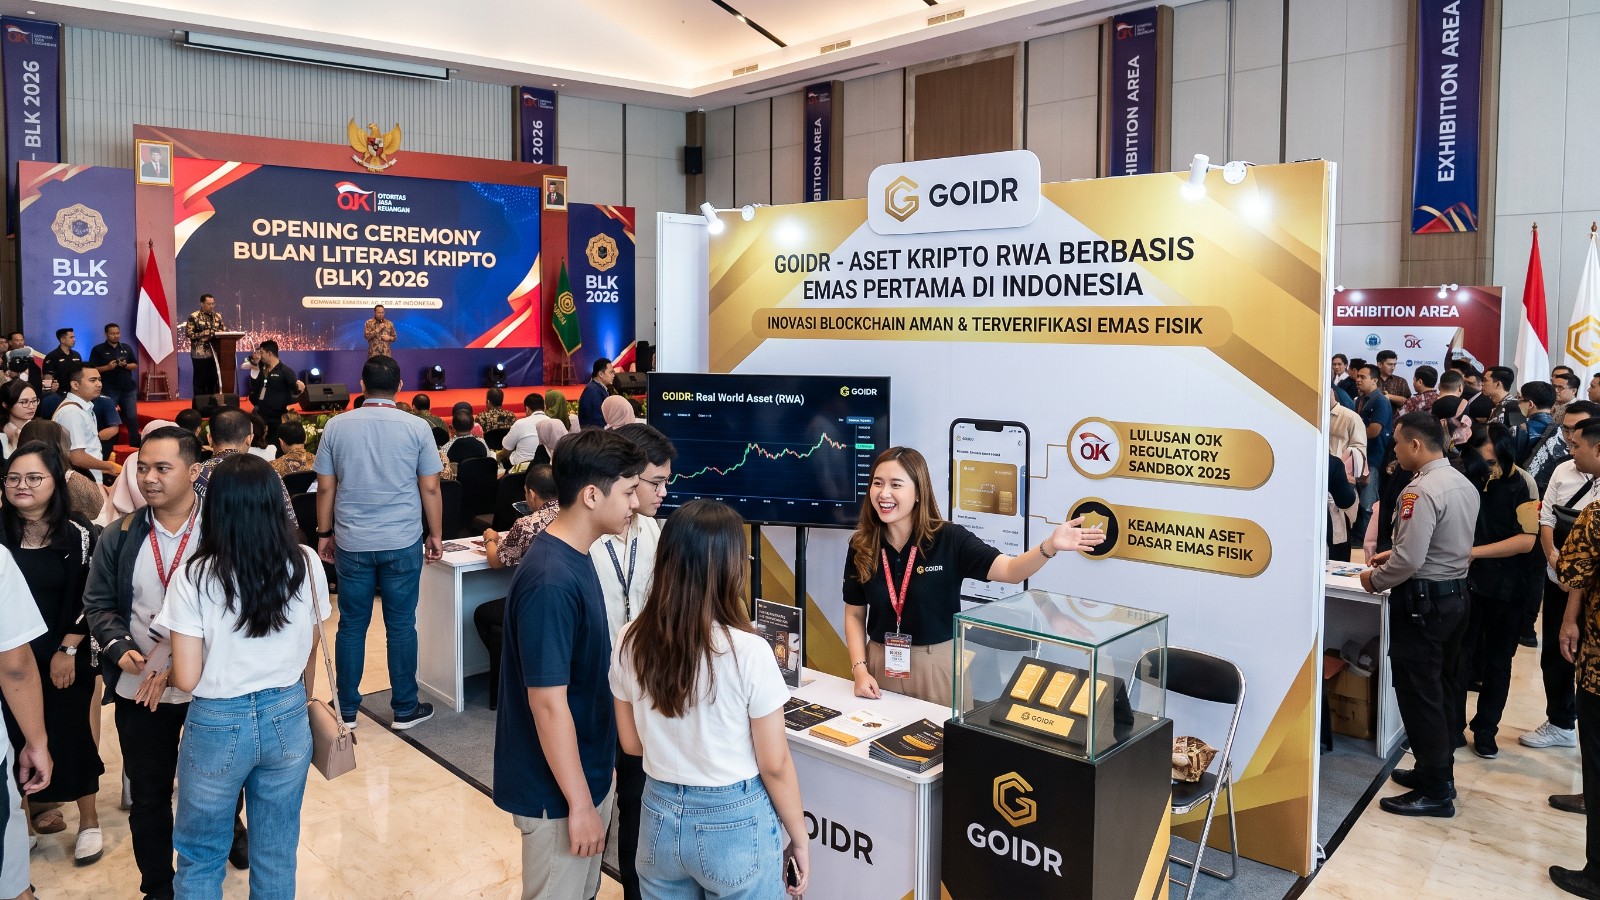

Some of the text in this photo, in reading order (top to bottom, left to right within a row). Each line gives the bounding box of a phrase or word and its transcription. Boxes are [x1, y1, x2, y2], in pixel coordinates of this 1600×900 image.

[23, 60, 41, 108] 2026
[1437, 0, 1461, 183] EXHIBITION AREA
[1125, 54, 1140, 176] HIBITION AREA
[24, 110, 42, 148] BLK
[532, 120, 544, 156] 2026
[813, 117, 822, 201] BITION AREA
[928, 177, 1019, 208] GOIDR
[252, 218, 481, 246] OPENING CEREMONY
[233, 241, 497, 268] BULAN LITERASI KRIPTO
[774, 252, 831, 274] GOIDR
[849, 249, 902, 272] ASET
[907, 245, 989, 270] KRIPTO
[996, 242, 1052, 267] RWA
[1059, 236, 1196, 265] BERBASIS
[53, 258, 108, 278] BLK
[315, 267, 429, 290] (BLK) 2026
[53, 279, 109, 296] 2026
[585, 275, 619, 290] BLK
[803, 272, 1144, 300] EMAS PERTAMA DI INDONESIA
[586, 290, 619, 303] 2026
[1336, 305, 1460, 318] EXHIBITION AREA
[767, 316, 1204, 335] INOVASI BLOCKCHAIN AMAN & TERVERIFIKASI EMAS FISIK
[662, 391, 805, 406] GOIDR: Real World Asset (RWA)
[851, 388, 878, 396] GOIDR
[1129, 428, 1223, 448] LULUSAN OJK
[1129, 444, 1219, 463] REGULATORY
[1128, 460, 1231, 481] SANDBOX 2025
[1128, 518, 1246, 544] KEAMANAN ASET
[1127, 534, 1254, 562] DASAR EMAS FISIK
[925, 565, 943, 573] GOIDR
[1031, 714, 1055, 726] GOIDR
[803, 810, 874, 866] OIDR
[966, 822, 1063, 878] GOIDR
